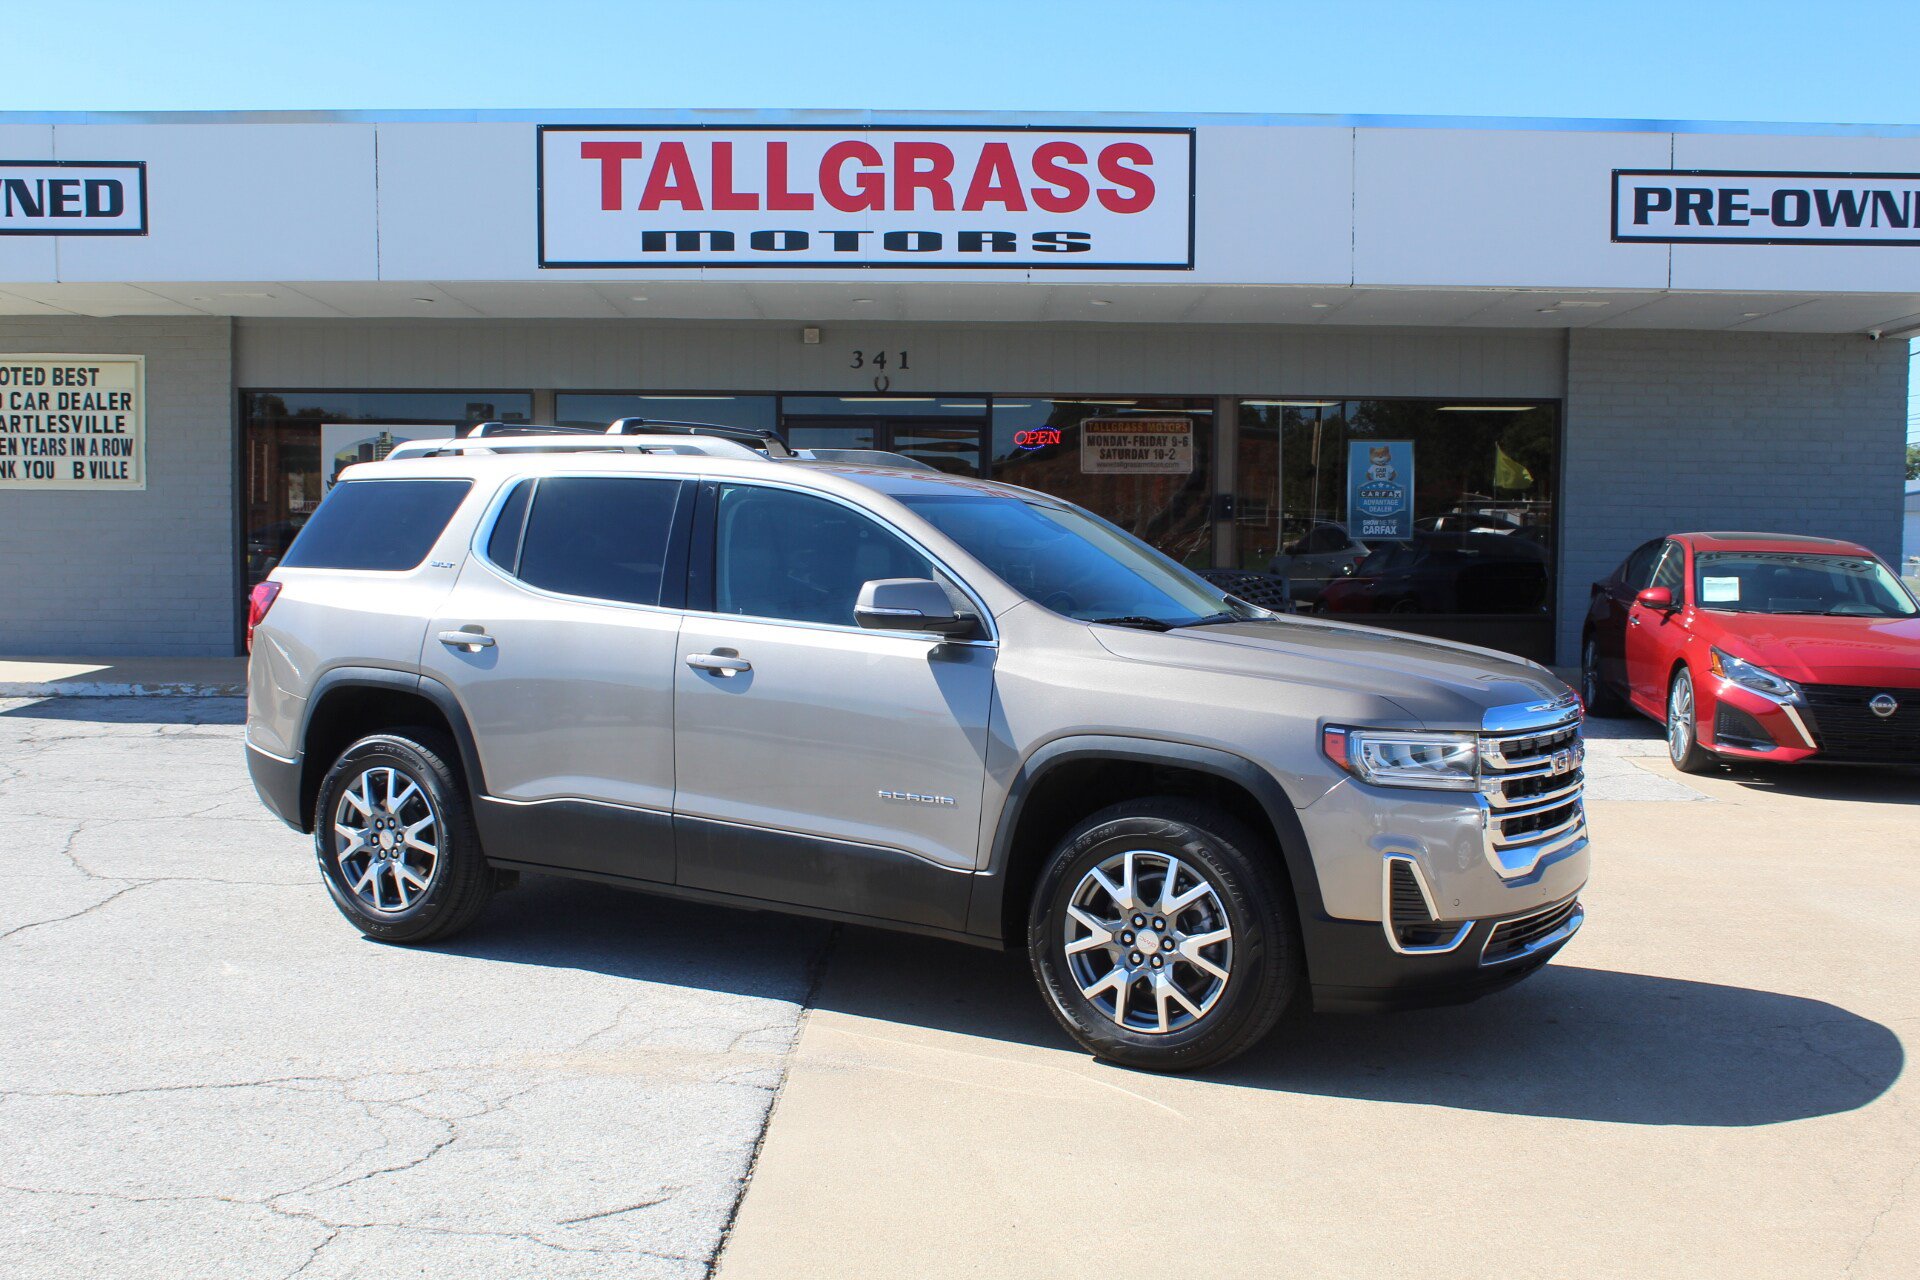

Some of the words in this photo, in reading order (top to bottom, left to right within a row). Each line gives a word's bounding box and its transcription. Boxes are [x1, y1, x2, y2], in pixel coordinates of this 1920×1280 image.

[580, 140, 1156, 213] TALLGRASS
[0, 178, 124, 217] NED
[1633, 187, 1920, 228] PRE-OWN
[641, 230, 1091, 252] MOTORS
[849, 350, 910, 370] 341
[0, 366, 45, 386] OTED
[52, 367, 99, 386] BEST
[10, 391, 49, 411] CAR
[58, 392, 131, 411] DEALER
[0, 414, 125, 434] ARTLESVILLE
[1089, 422, 1143, 432] TALLGRASS
[1147, 423, 1188, 433] MOTORS
[0, 437, 17, 456] EN
[22, 437, 66, 456] YEARS
[71, 437, 85, 456] IN
[90, 438, 99, 456] A
[102, 438, 133, 457] ROW
[1014, 430, 1062, 445] OPEN
[1171, 436, 1189, 447] 9-6
[1099, 448, 1150, 460] SATURDAY
[1153, 448, 1176, 460] 10-2
[24, 460, 54, 479] YOU
[73, 460, 84, 479] B
[90, 460, 128, 479] VILLE
[1361, 490, 1402, 498] CARFAX
[1363, 526, 1397, 535] CARFAX
[878, 790, 955, 805] ACADIA
